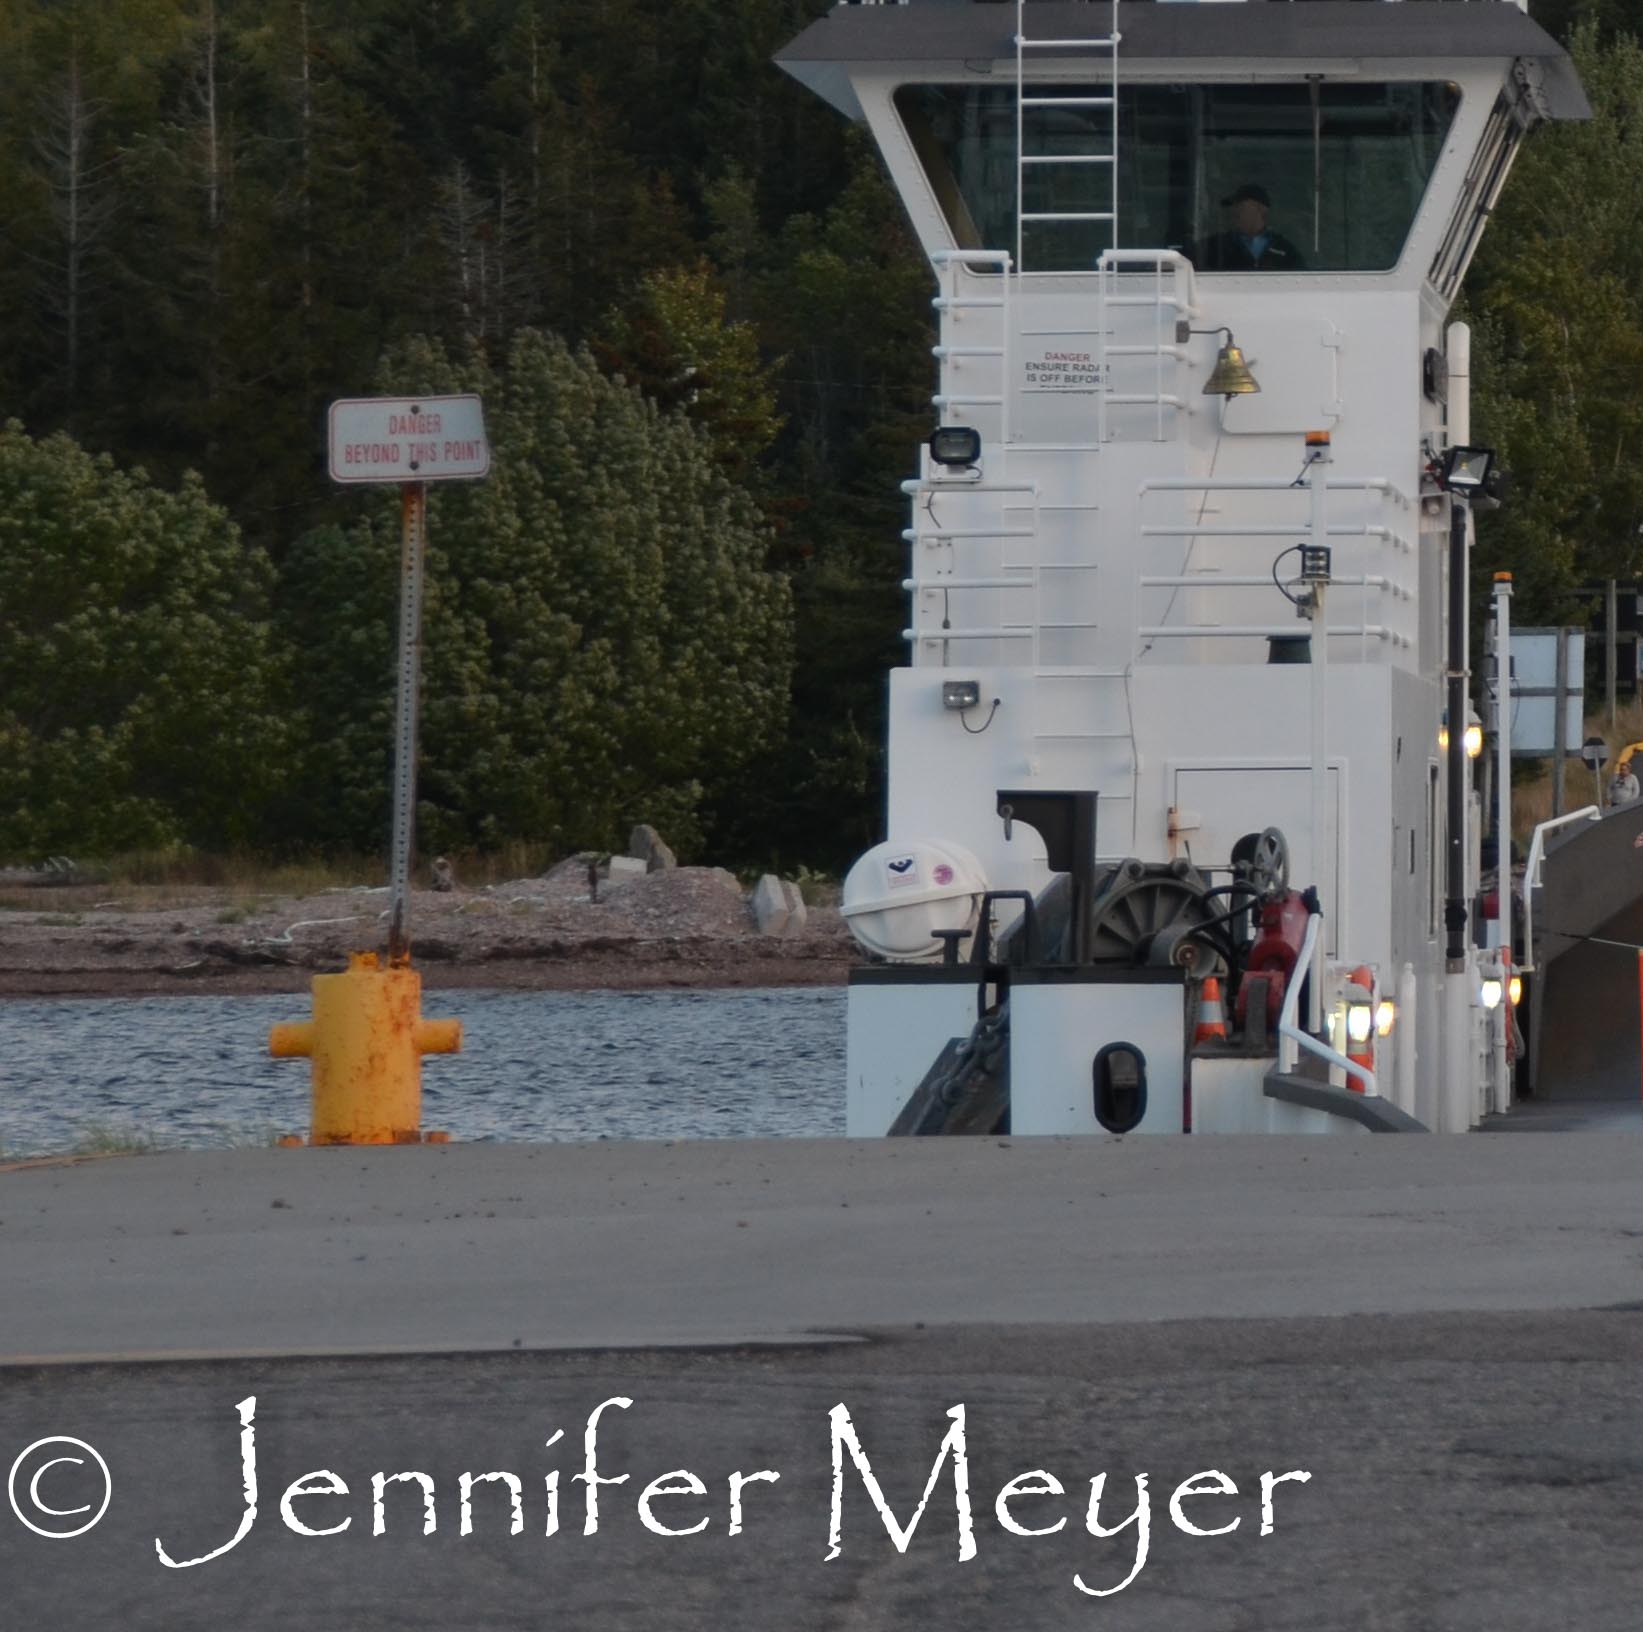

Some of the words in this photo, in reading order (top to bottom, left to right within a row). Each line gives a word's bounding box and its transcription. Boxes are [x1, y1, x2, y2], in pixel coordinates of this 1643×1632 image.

[1044, 351, 1091, 362] DANGER
[1025, 362, 1070, 372] ENSURE
[1026, 373, 1037, 383] IS
[1040, 373, 1061, 383] OFF
[389, 413, 442, 436] DANGER
[344, 443, 400, 465] BEYOND
[407, 442, 437, 463] THIS
[444, 440, 482, 462] POINT
